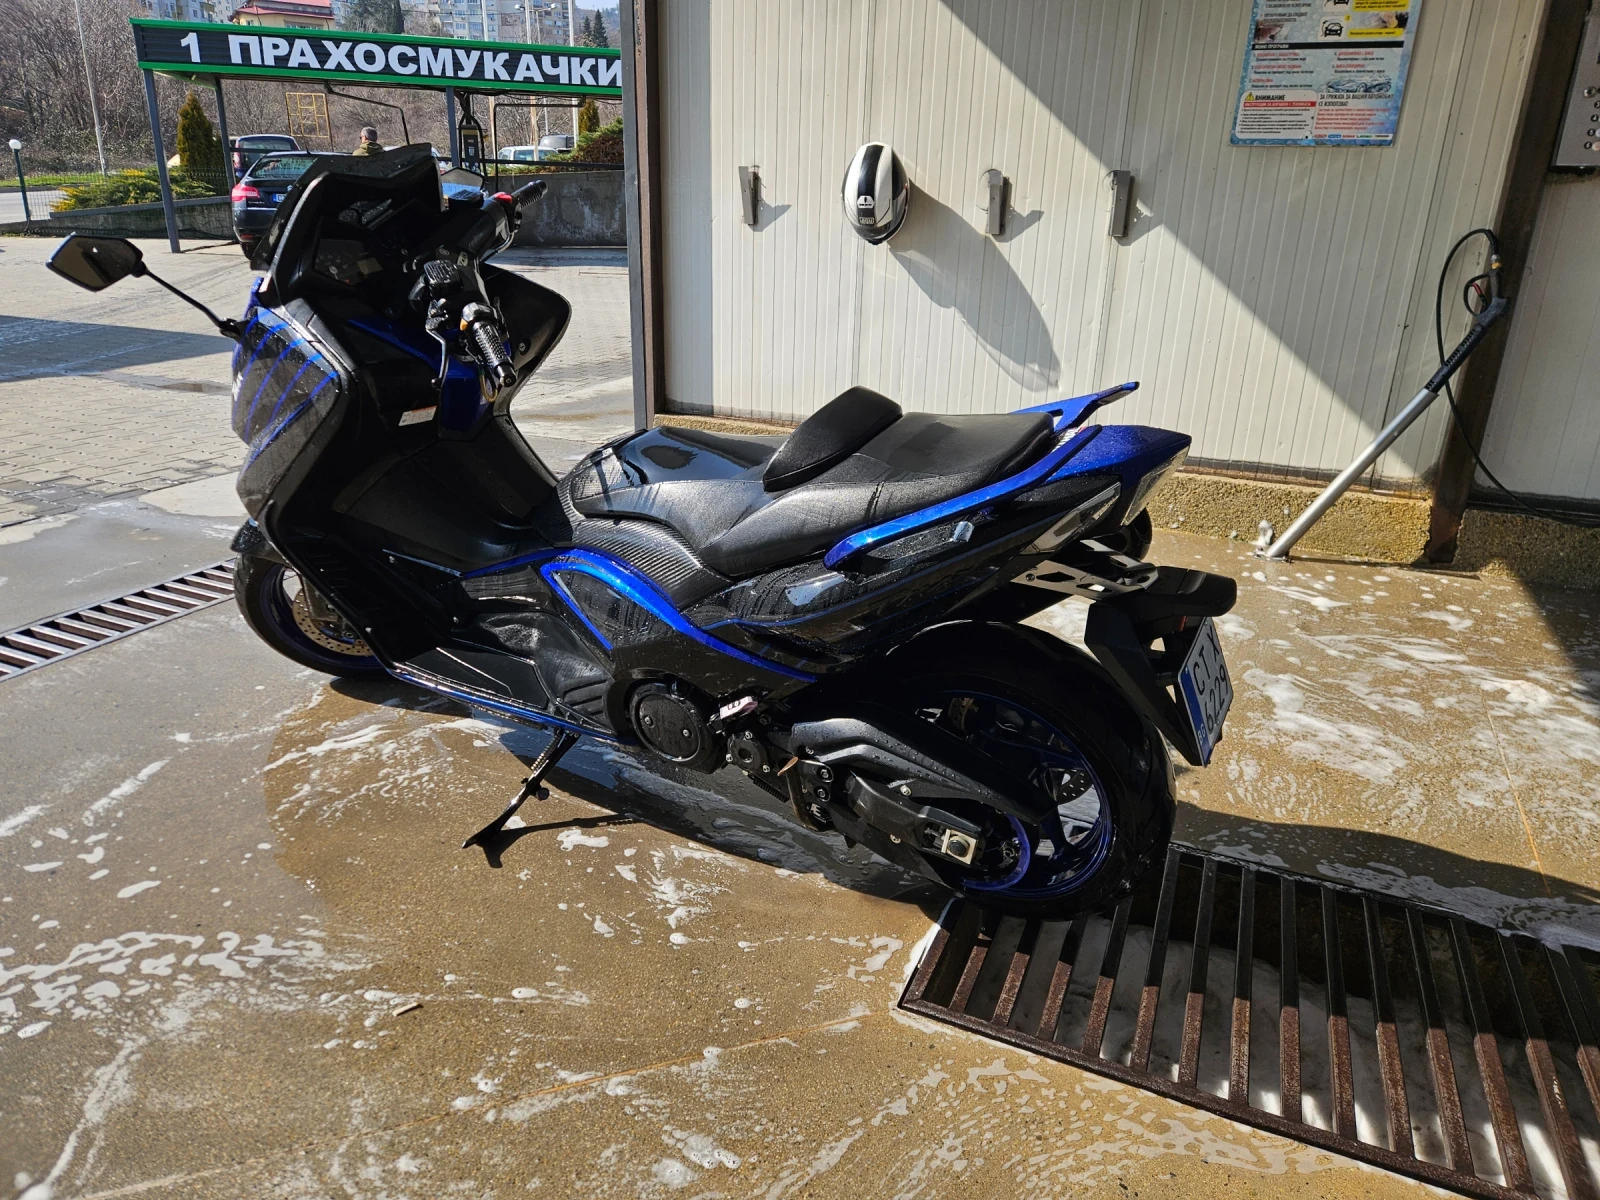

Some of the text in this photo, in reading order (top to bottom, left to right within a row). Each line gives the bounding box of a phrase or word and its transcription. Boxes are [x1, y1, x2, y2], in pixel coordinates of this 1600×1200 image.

[180, 32, 623, 88] 1 ПРАХОСМУКАЧКИ
[1204, 664, 1229, 735] 6229
[1198, 721, 1207, 743] BG
